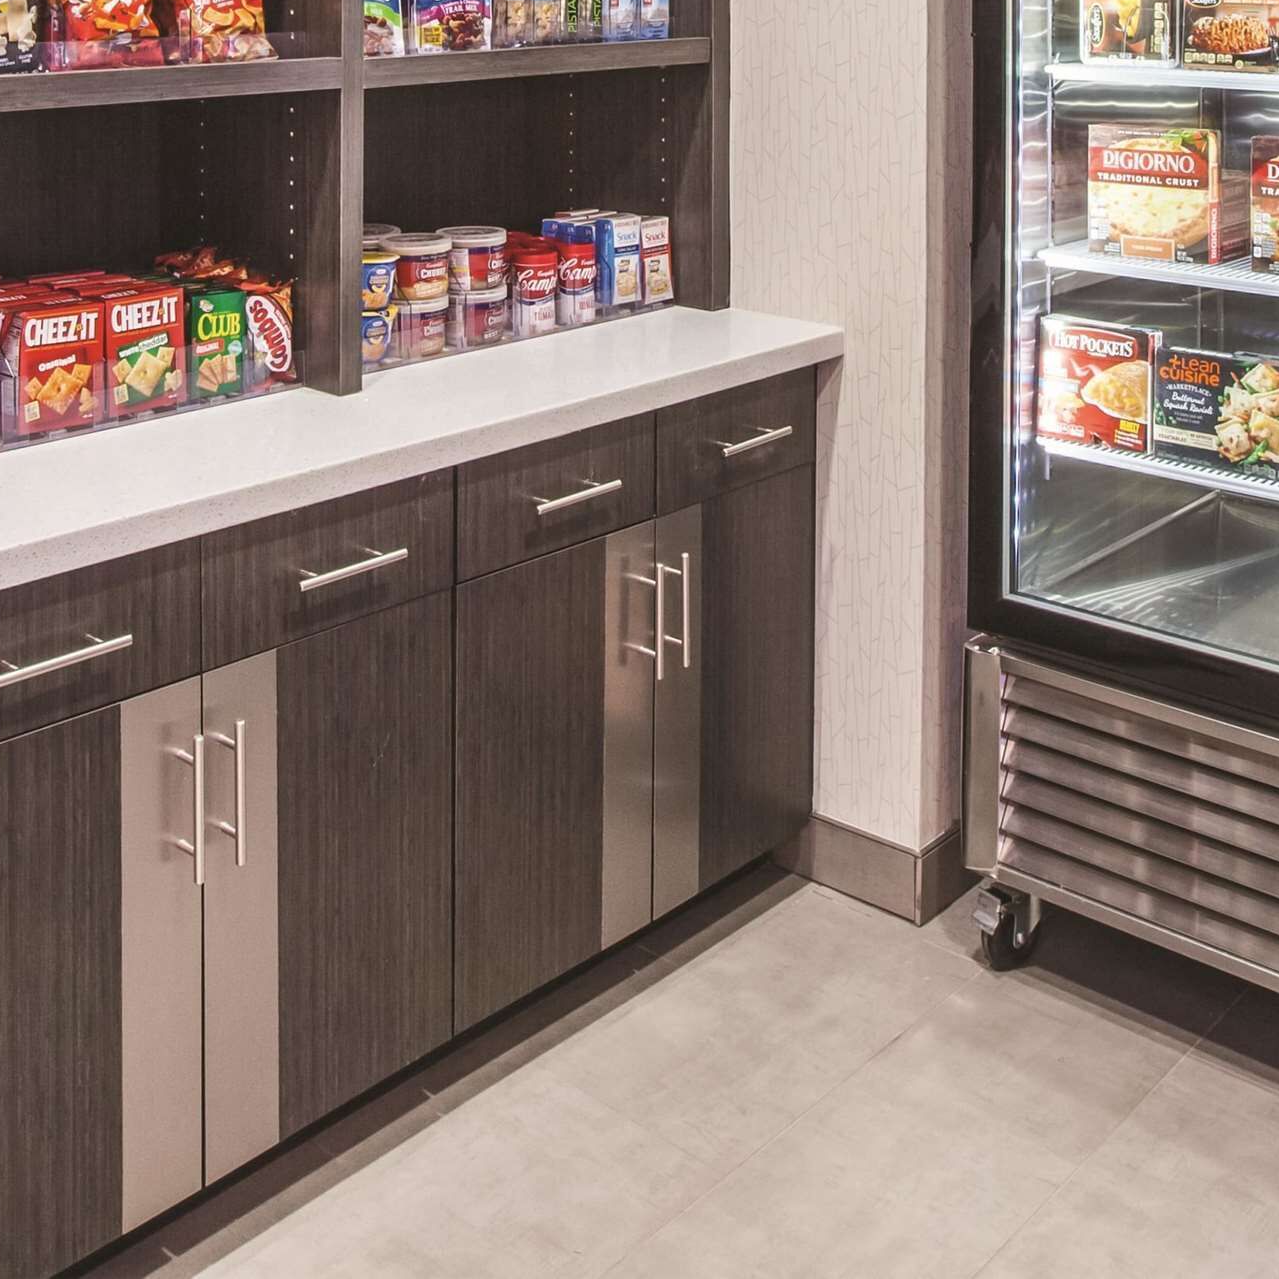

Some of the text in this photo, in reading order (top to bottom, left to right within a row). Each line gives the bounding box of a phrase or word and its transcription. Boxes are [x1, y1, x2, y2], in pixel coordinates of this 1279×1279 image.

[1097, 172, 1200, 187] TRADITIONAL CRUST
[616, 231, 637, 241] Snack
[645, 232, 665, 242] Snack
[197, 312, 240, 341] CLUB
[1080, 334, 1134, 358] POCKETS
[1172, 391, 1205, 406] Butternut
[1163, 399, 1214, 416] Squash Ravioli
